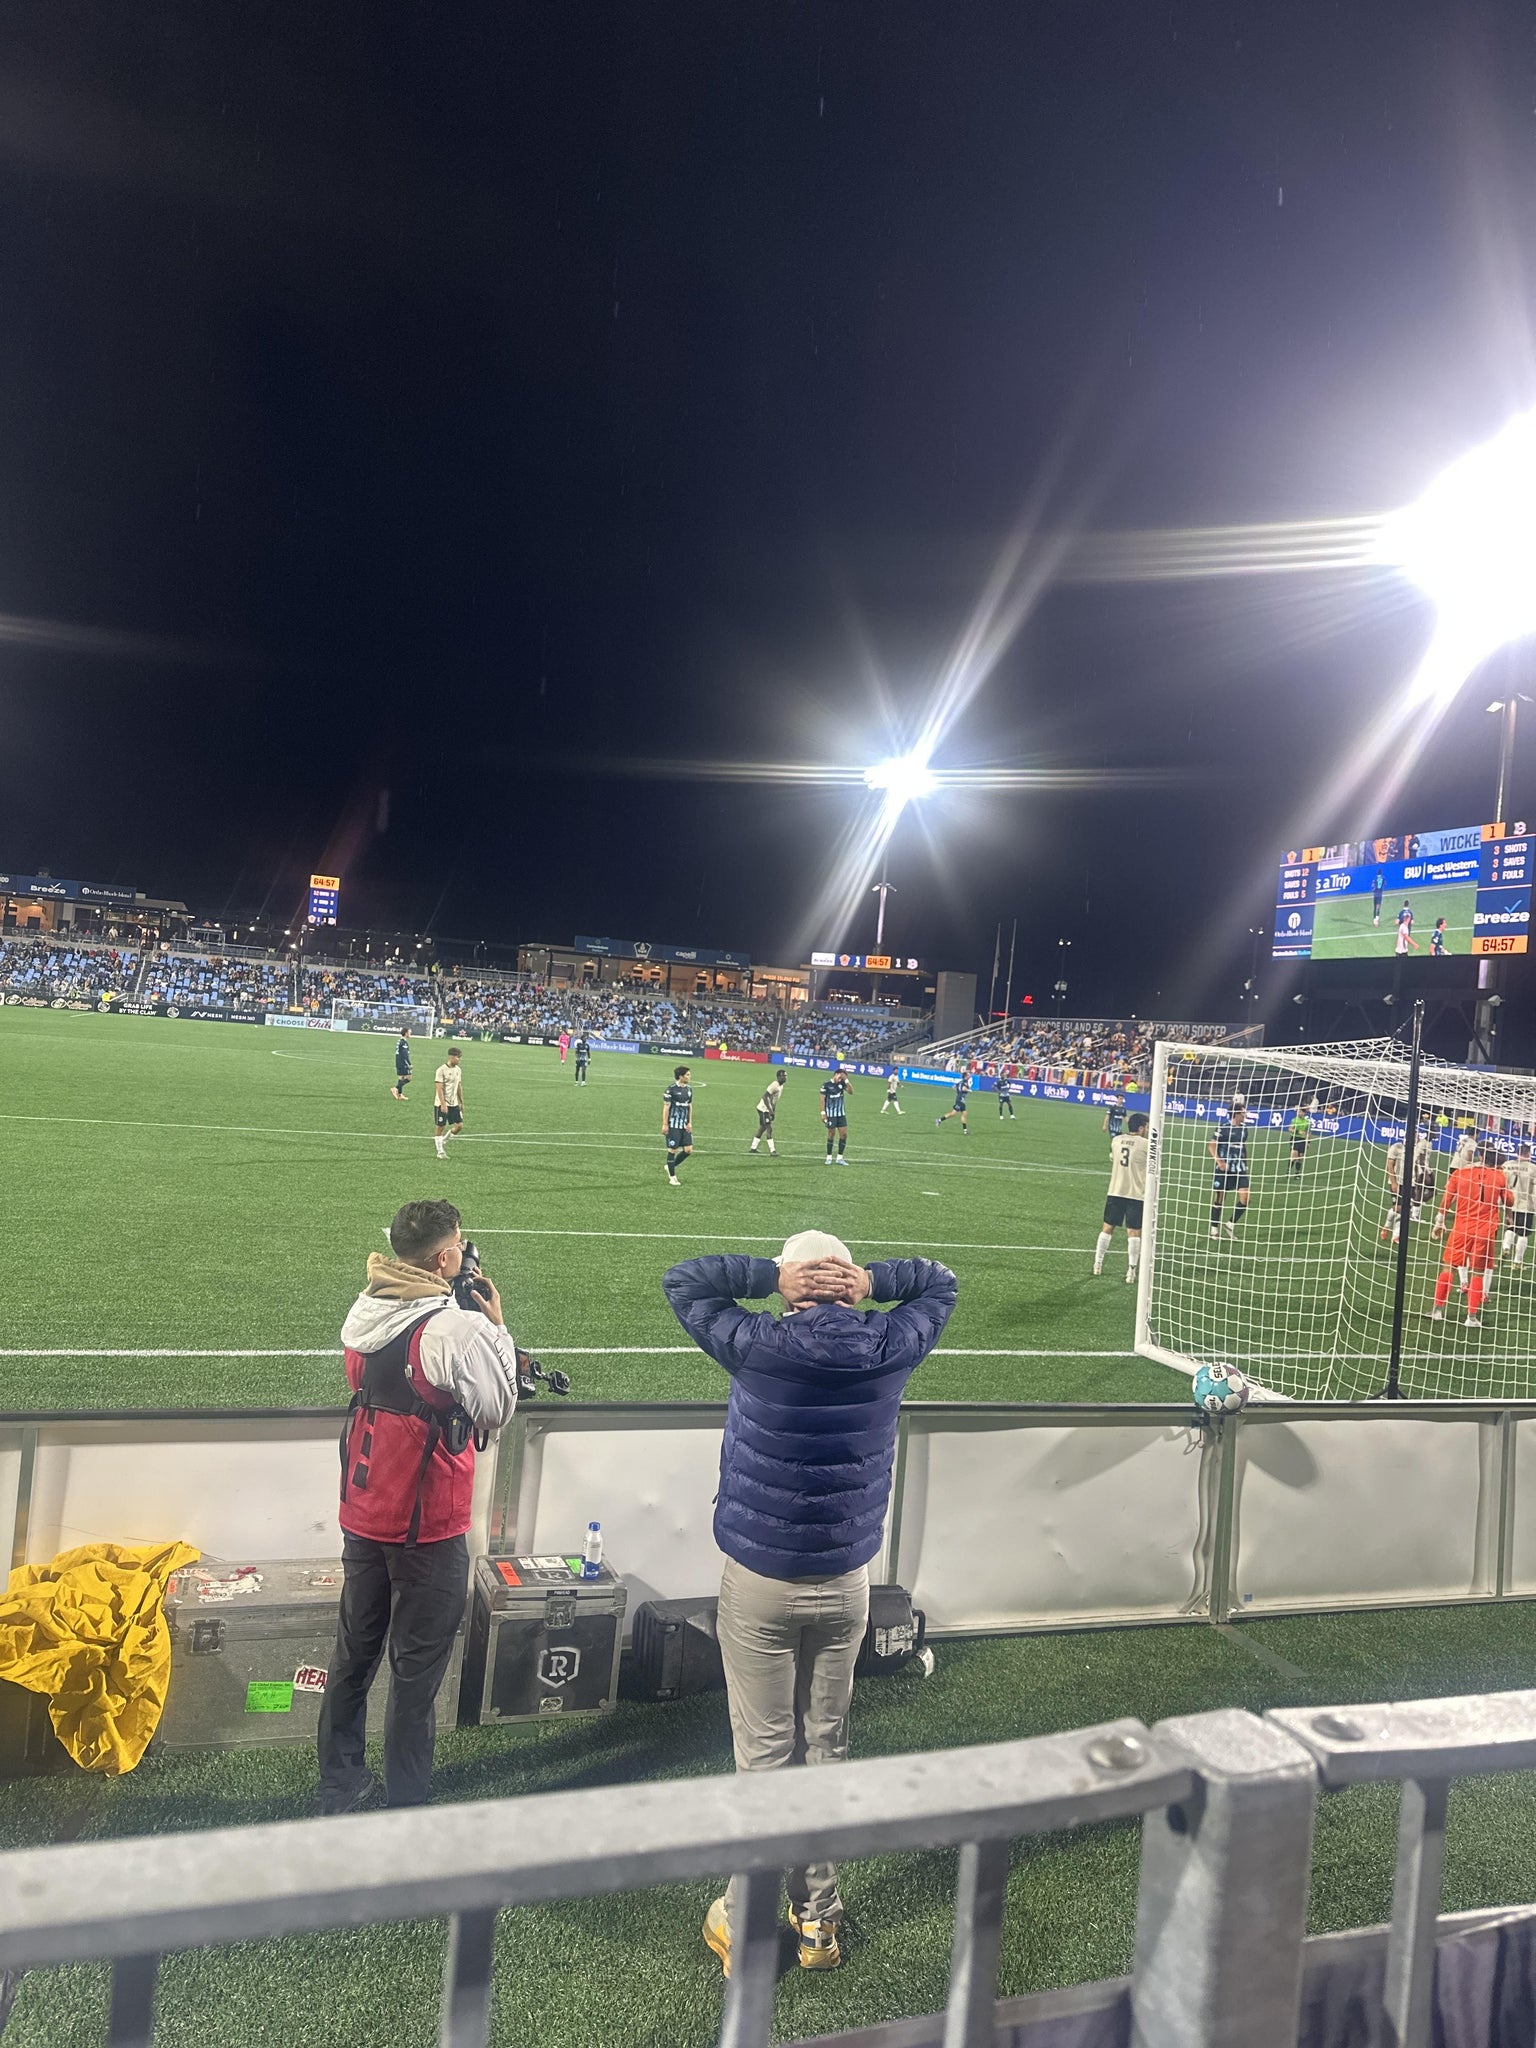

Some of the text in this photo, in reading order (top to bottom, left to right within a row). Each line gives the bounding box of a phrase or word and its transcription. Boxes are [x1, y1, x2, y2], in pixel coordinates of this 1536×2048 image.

[1490, 826, 1496, 838] 1
[1440, 832, 1481, 852] WICKE
[1504, 843, 1528, 854] SHOTS
[1503, 856, 1526, 867] SAVES
[1403, 866, 1422, 880] BW
[1502, 869, 1524, 880] FOULS
[313, 877, 336, 887] 64:57
[1322, 878, 1330, 889] a
[1330, 873, 1351, 890] Trip
[1473, 911, 1530, 925] Breeze
[1482, 938, 1516, 952] 64:57
[867, 957, 889, 966] 64:57
[276, 1019, 305, 1027] CHOOSE
[1172, 1100, 1185, 1113] Trip
[1323, 1118, 1340, 1133] Trip
[1120, 1147, 1130, 1168] 3
[549, 1655, 568, 1677] R
